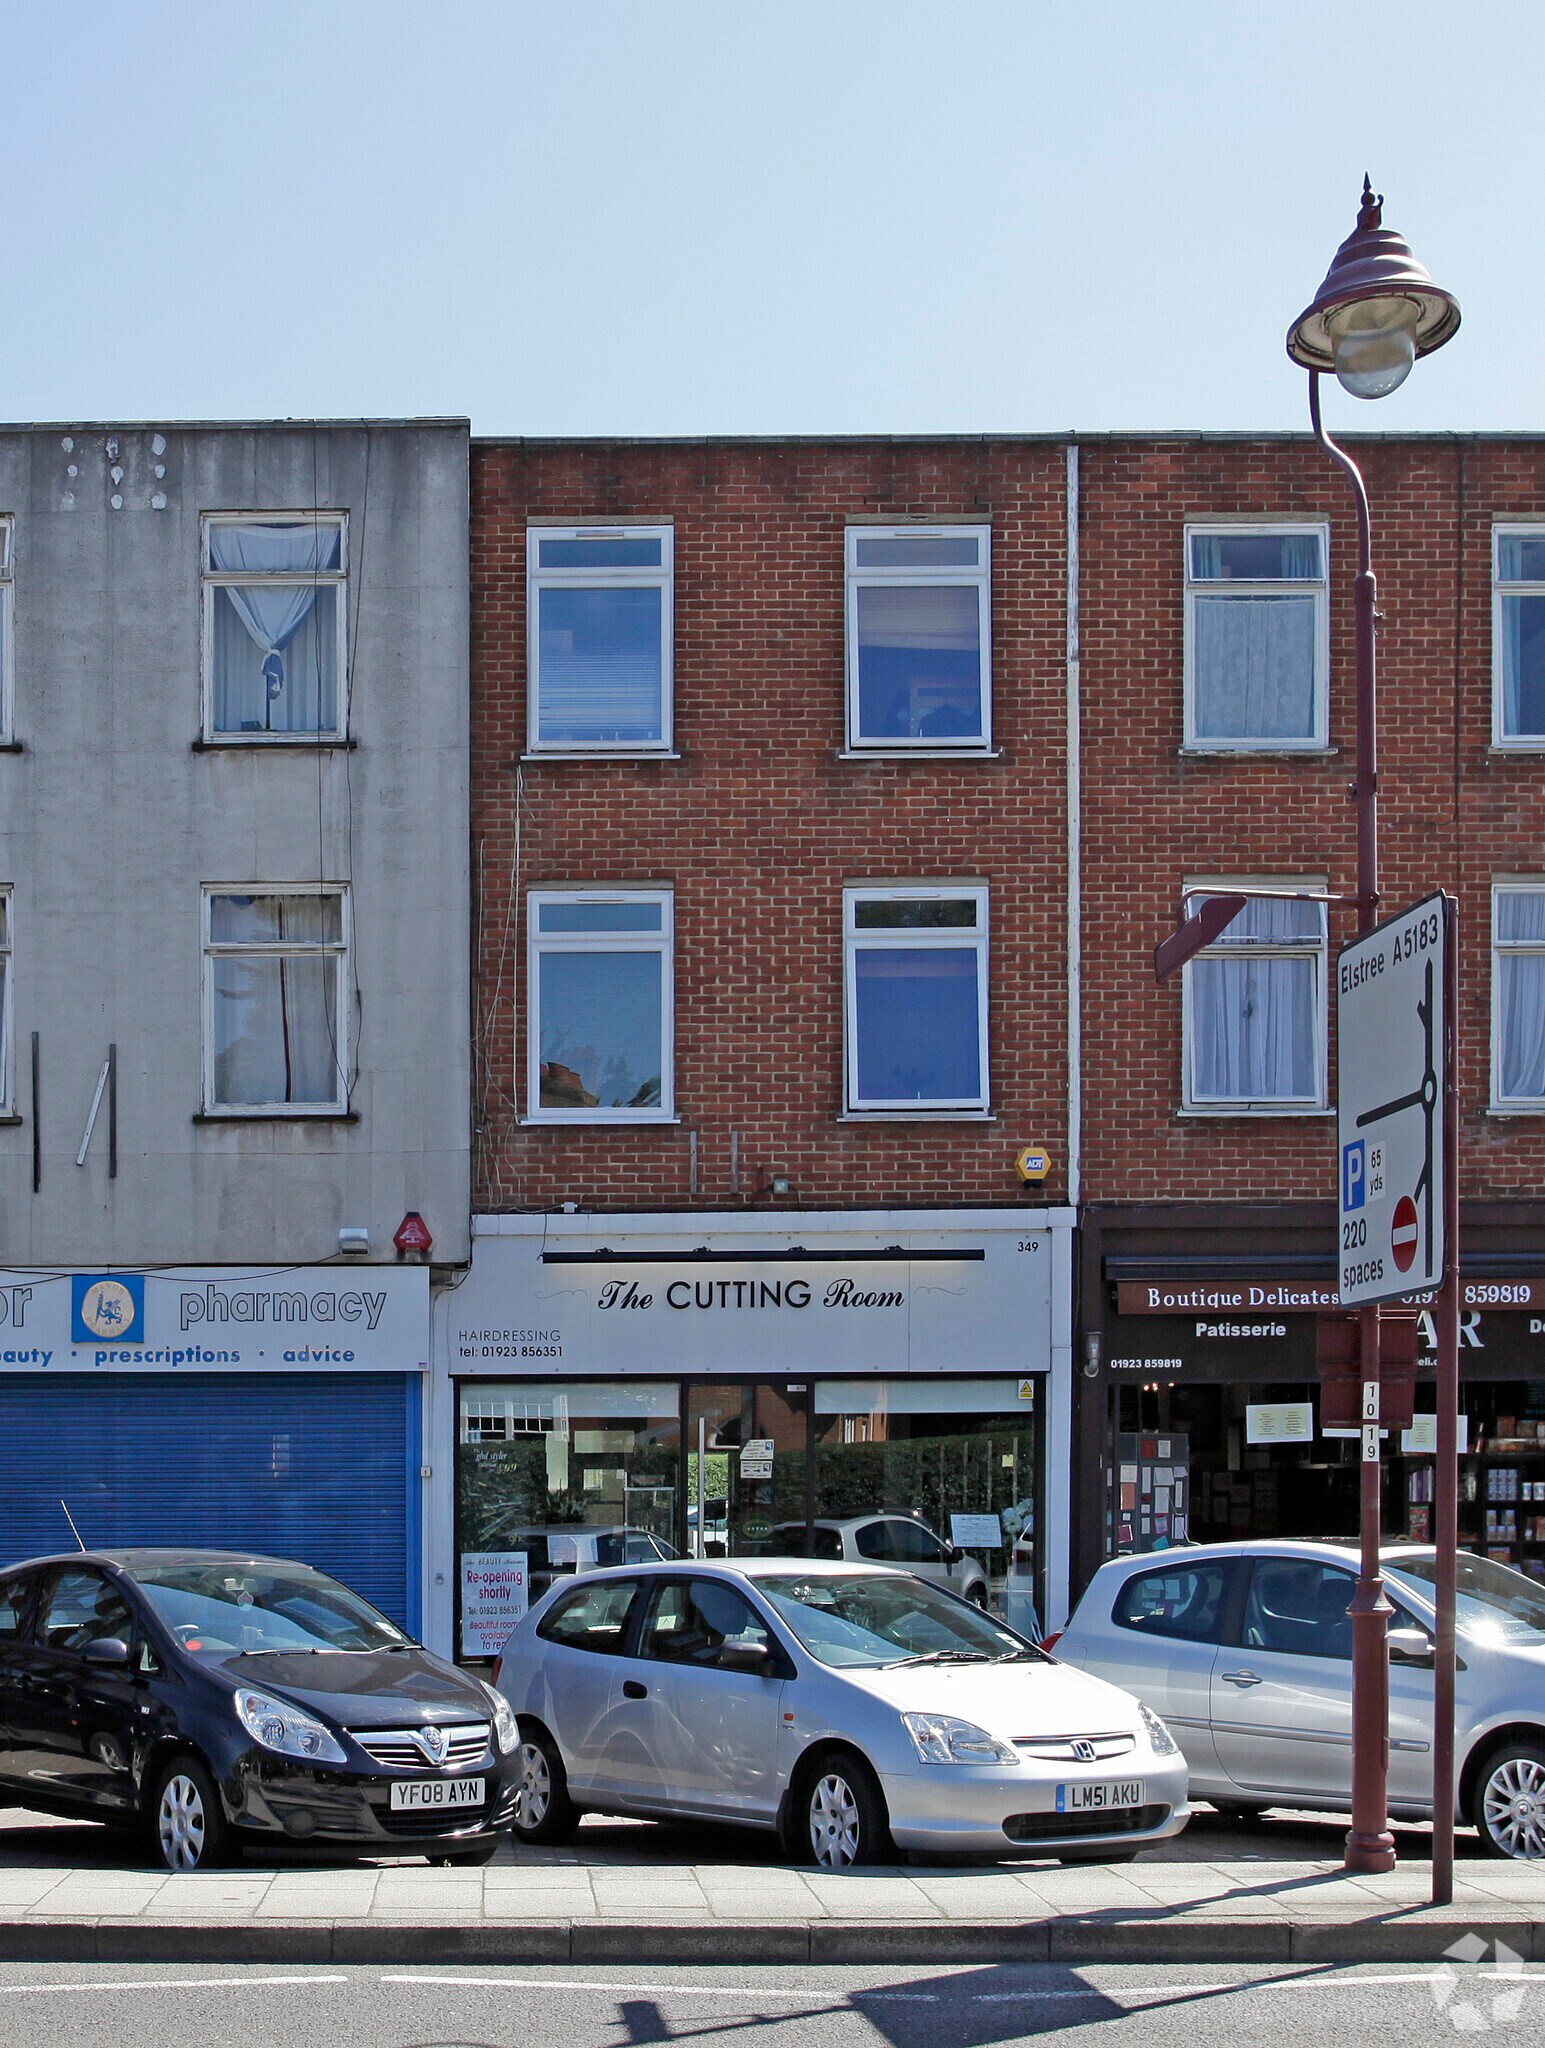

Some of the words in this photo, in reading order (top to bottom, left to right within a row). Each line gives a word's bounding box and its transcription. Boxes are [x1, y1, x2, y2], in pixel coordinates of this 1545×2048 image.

[1341, 952, 1385, 995] Elstree
[1392, 913, 1438, 967] A5183
[1026, 1159, 1044, 1169] ADT
[1370, 1149, 1382, 1169] 65
[1347, 1147, 1362, 1206] P
[1369, 1173, 1383, 1196] yds
[1343, 1218, 1367, 1250] 220
[1017, 1241, 1039, 1253] 349
[1343, 1258, 1384, 1292] spaces
[597, 1280, 654, 1310] The
[666, 1280, 812, 1309] CUTTING
[822, 1278, 905, 1308] Room
[1148, 1288, 1242, 1308] Boutique
[1464, 1285, 1531, 1304] 859819
[0, 1287, 33, 1328] r
[180, 1284, 387, 1330] pharmacy
[1195, 1322, 1287, 1337] Patisserie
[1530, 1319, 1545, 1333] D
[459, 1330, 561, 1342] HAIRDRESSING
[0, 1348, 53, 1367] auty
[95, 1345, 241, 1366] prescriptions
[282, 1345, 355, 1363] advice
[459, 1346, 478, 1357] tel:
[482, 1346, 517, 1357] 01923
[521, 1346, 563, 1358] 856351
[1110, 1359, 1142, 1369] 01923
[1144, 1358, 1183, 1369] 859819
[478, 1557, 502, 1566] BEAUTY
[467, 1569, 523, 1586] Re-opening
[479, 1586, 512, 1601] shortly
[480, 1605, 498, 1615] 01923
[499, 1605, 522, 1615] 856351
[469, 1621, 499, 1630] Beautiful
[482, 1640, 491, 1650] to
[398, 1783, 444, 1805] YF08
[448, 1780, 478, 1802] AYN
[1071, 1786, 1107, 1808] LM51
[1112, 1783, 1140, 1805] AKU
